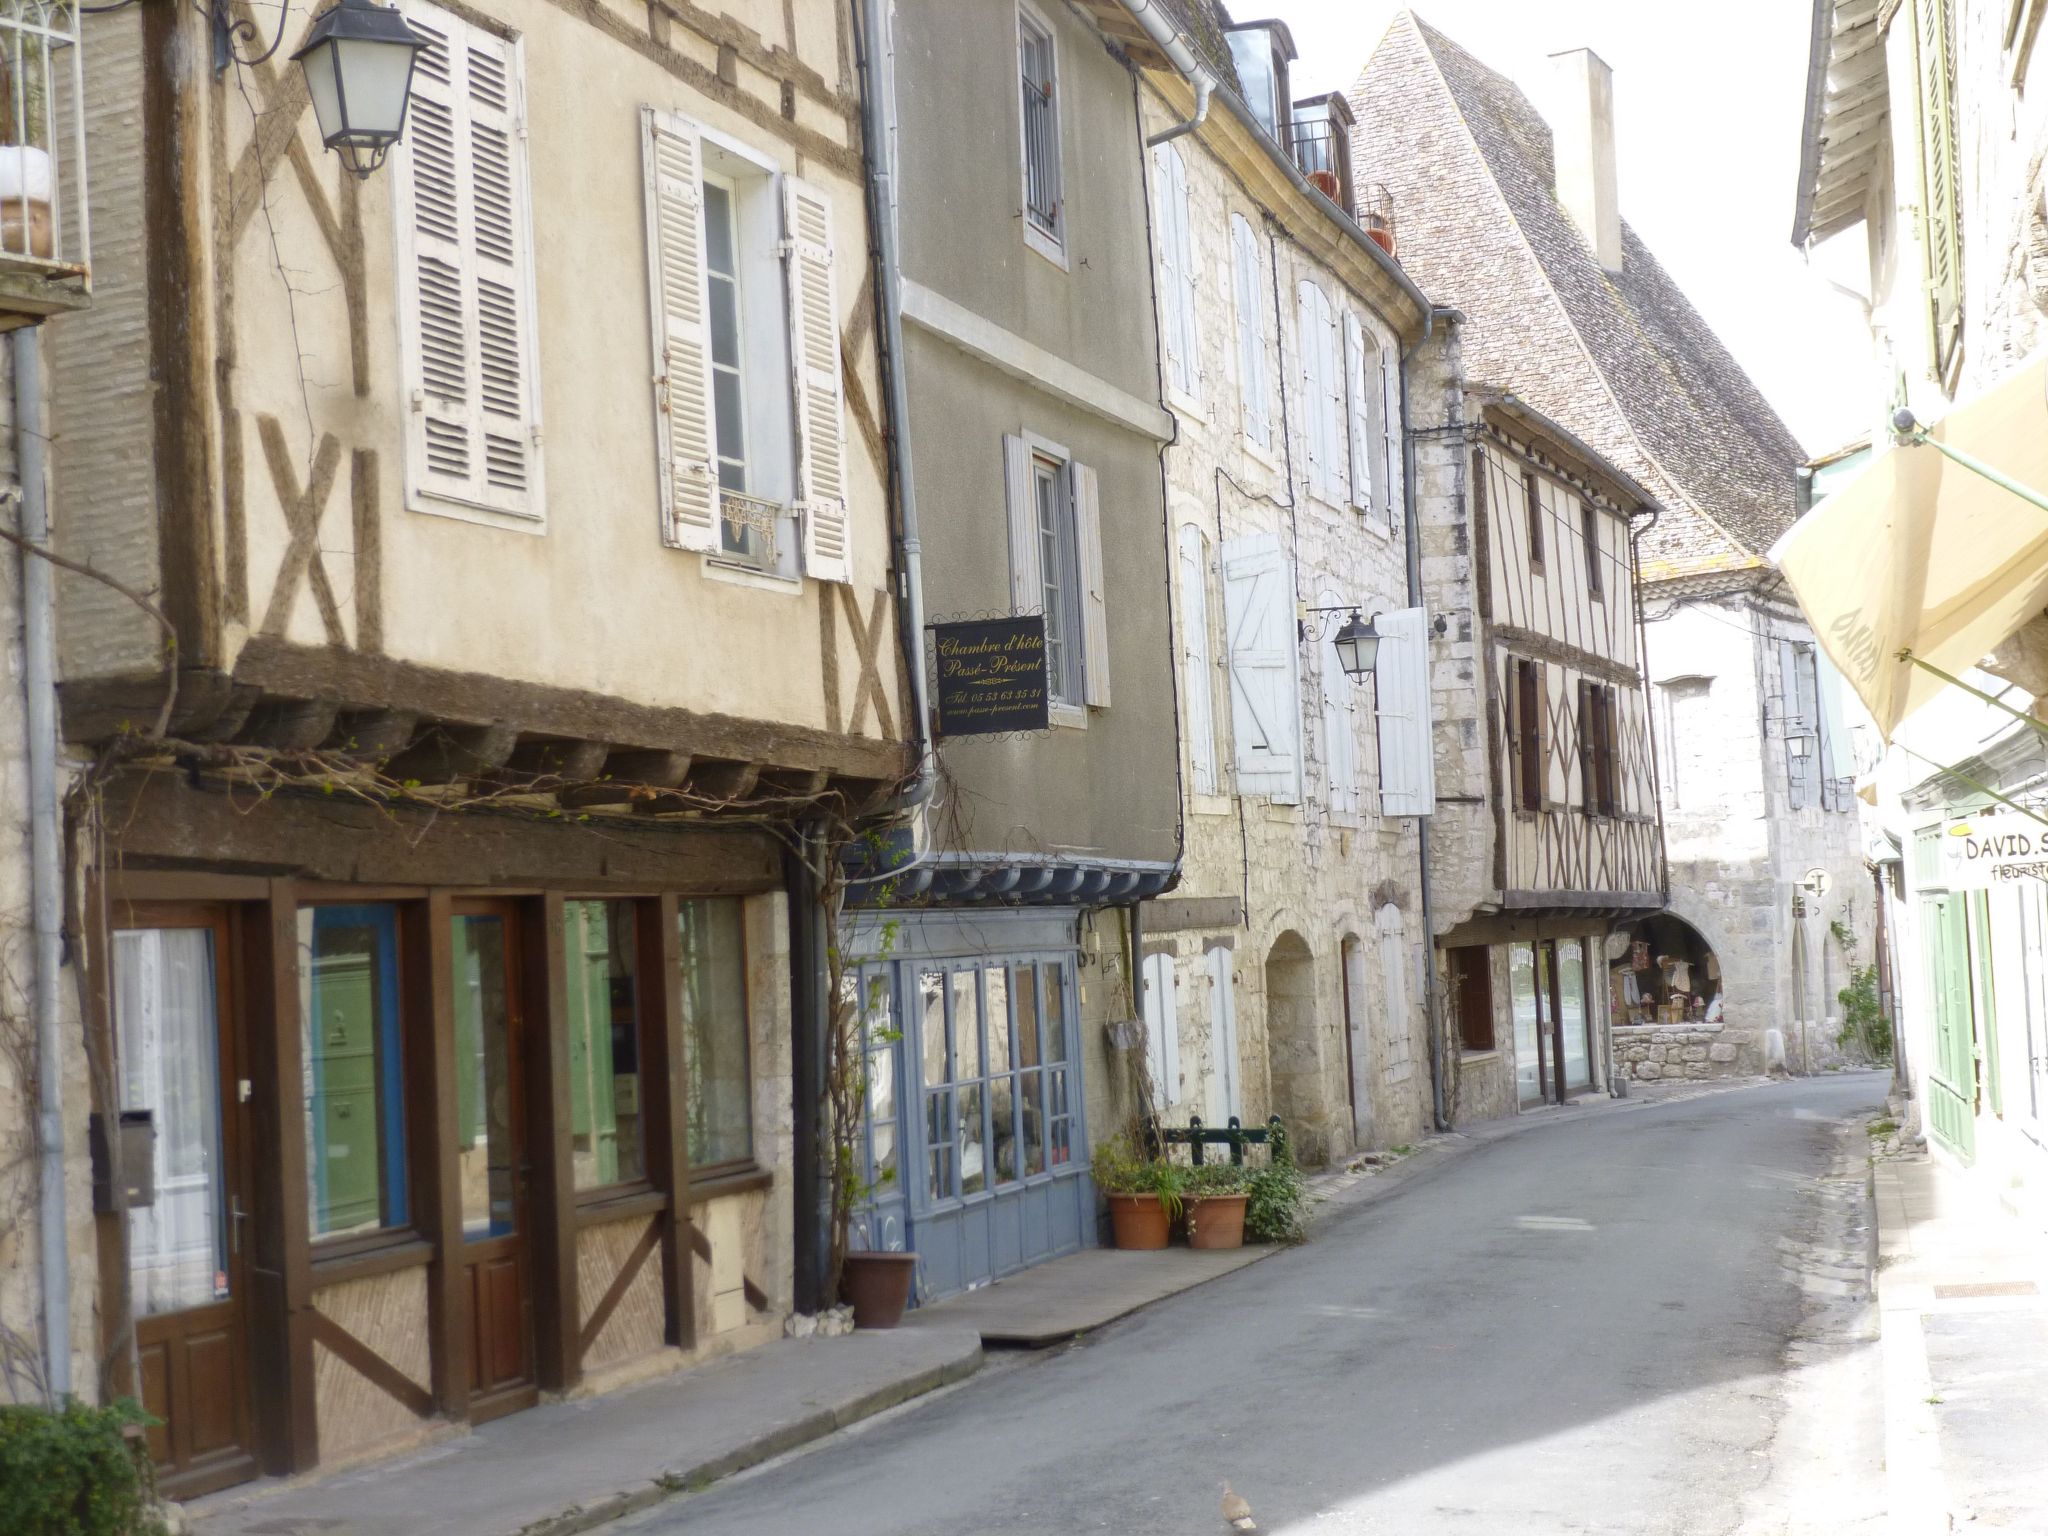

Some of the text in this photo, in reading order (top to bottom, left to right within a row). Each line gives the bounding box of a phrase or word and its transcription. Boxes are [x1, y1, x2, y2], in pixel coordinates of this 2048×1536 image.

[938, 633, 1043, 657] Chambre d'hôte
[971, 693, 983, 703] 05
[985, 692, 998, 702] 53
[1000, 690, 1013, 701] 63
[1015, 689, 1028, 700] 35
[1029, 688, 1042, 699] 31
